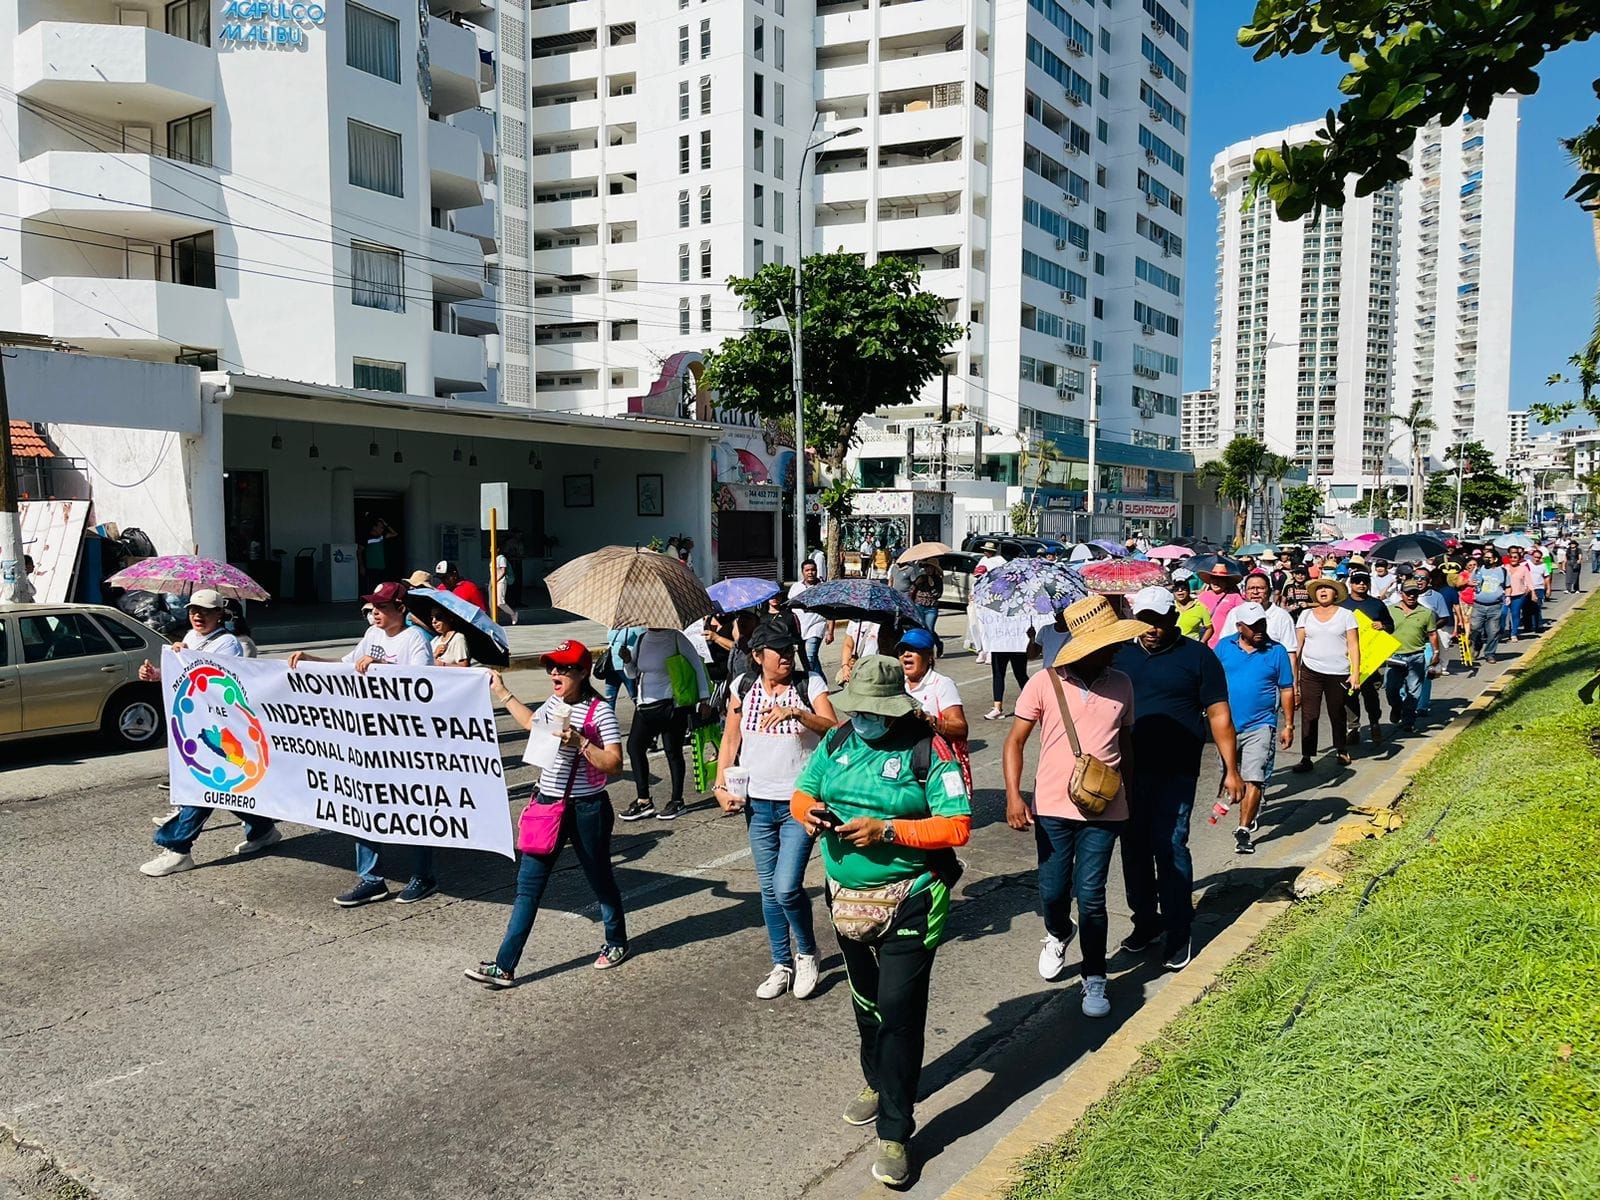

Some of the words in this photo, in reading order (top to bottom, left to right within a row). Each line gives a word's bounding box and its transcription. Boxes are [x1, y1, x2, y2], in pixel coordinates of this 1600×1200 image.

[225, 1, 325, 22] ACAPULCO
[219, 24, 303, 45] MALIBU
[1125, 504, 1144, 514] SUSHI
[287, 672, 434, 703] MOVIMIENTO
[260, 703, 425, 737] INDEPENDIENTE
[431, 717, 496, 743] PAAE
[271, 734, 345, 762] PERSONAL
[348, 746, 502, 778] ADMINISTRATIVO
[204, 791, 256, 810] GUERRERO
[307, 769, 329, 791] DE
[334, 775, 451, 807] ASISTENCIA
[459, 787, 476, 809] A
[316, 799, 337, 822] LA
[342, 805, 469, 838] EDUCACIÓN
